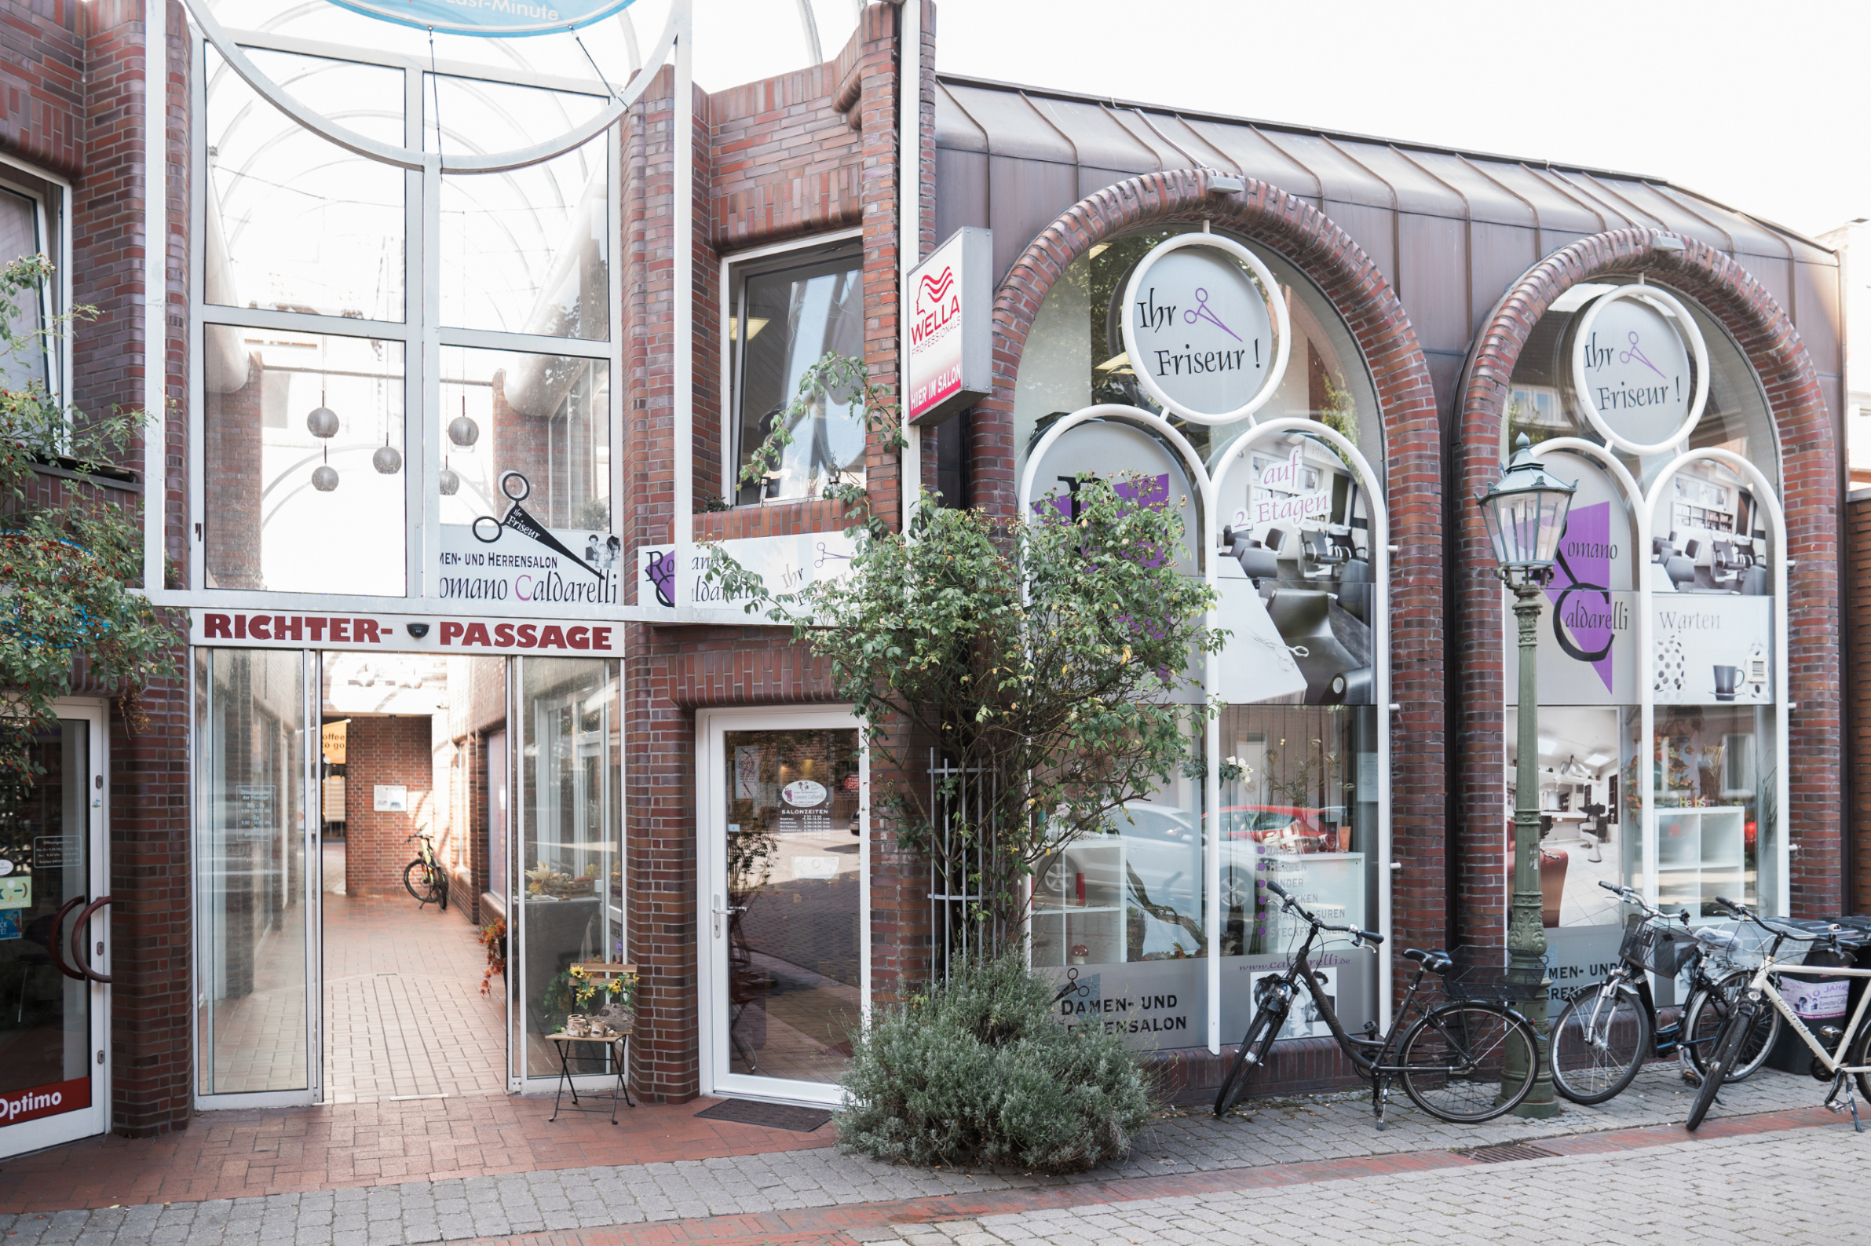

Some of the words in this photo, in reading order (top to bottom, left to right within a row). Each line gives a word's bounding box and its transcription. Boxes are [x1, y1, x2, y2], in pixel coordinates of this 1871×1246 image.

[911, 295, 960, 346] WELLA
[1137, 287, 1176, 333] Ihr
[911, 316, 961, 358] PROFESSIONALS
[1584, 331, 1614, 372] Ihr
[1153, 343, 1245, 376] Friseur
[910, 388, 927, 411] HIER
[928, 379, 937, 400] IM
[938, 362, 961, 393] SALON
[1596, 381, 1669, 411] Friseur
[1263, 449, 1299, 487] auf
[506, 515, 541, 540] Friseur
[1234, 511, 1249, 528] 2
[1256, 494, 1329, 525] Etagen
[465, 553, 484, 566] UND
[488, 552, 558, 569] HERRENSALON
[515, 568, 617, 604] Caldarelli
[204, 613, 393, 643] RICHTER-
[440, 621, 612, 650] PASSAGE
[1552, 582, 1628, 662] Caldarelli
[1658, 611, 1721, 630] Warten
[1270, 862, 1307, 873] HERREN
[1061, 997, 1134, 1016] DAMEN-
[1141, 994, 1178, 1009] UND
